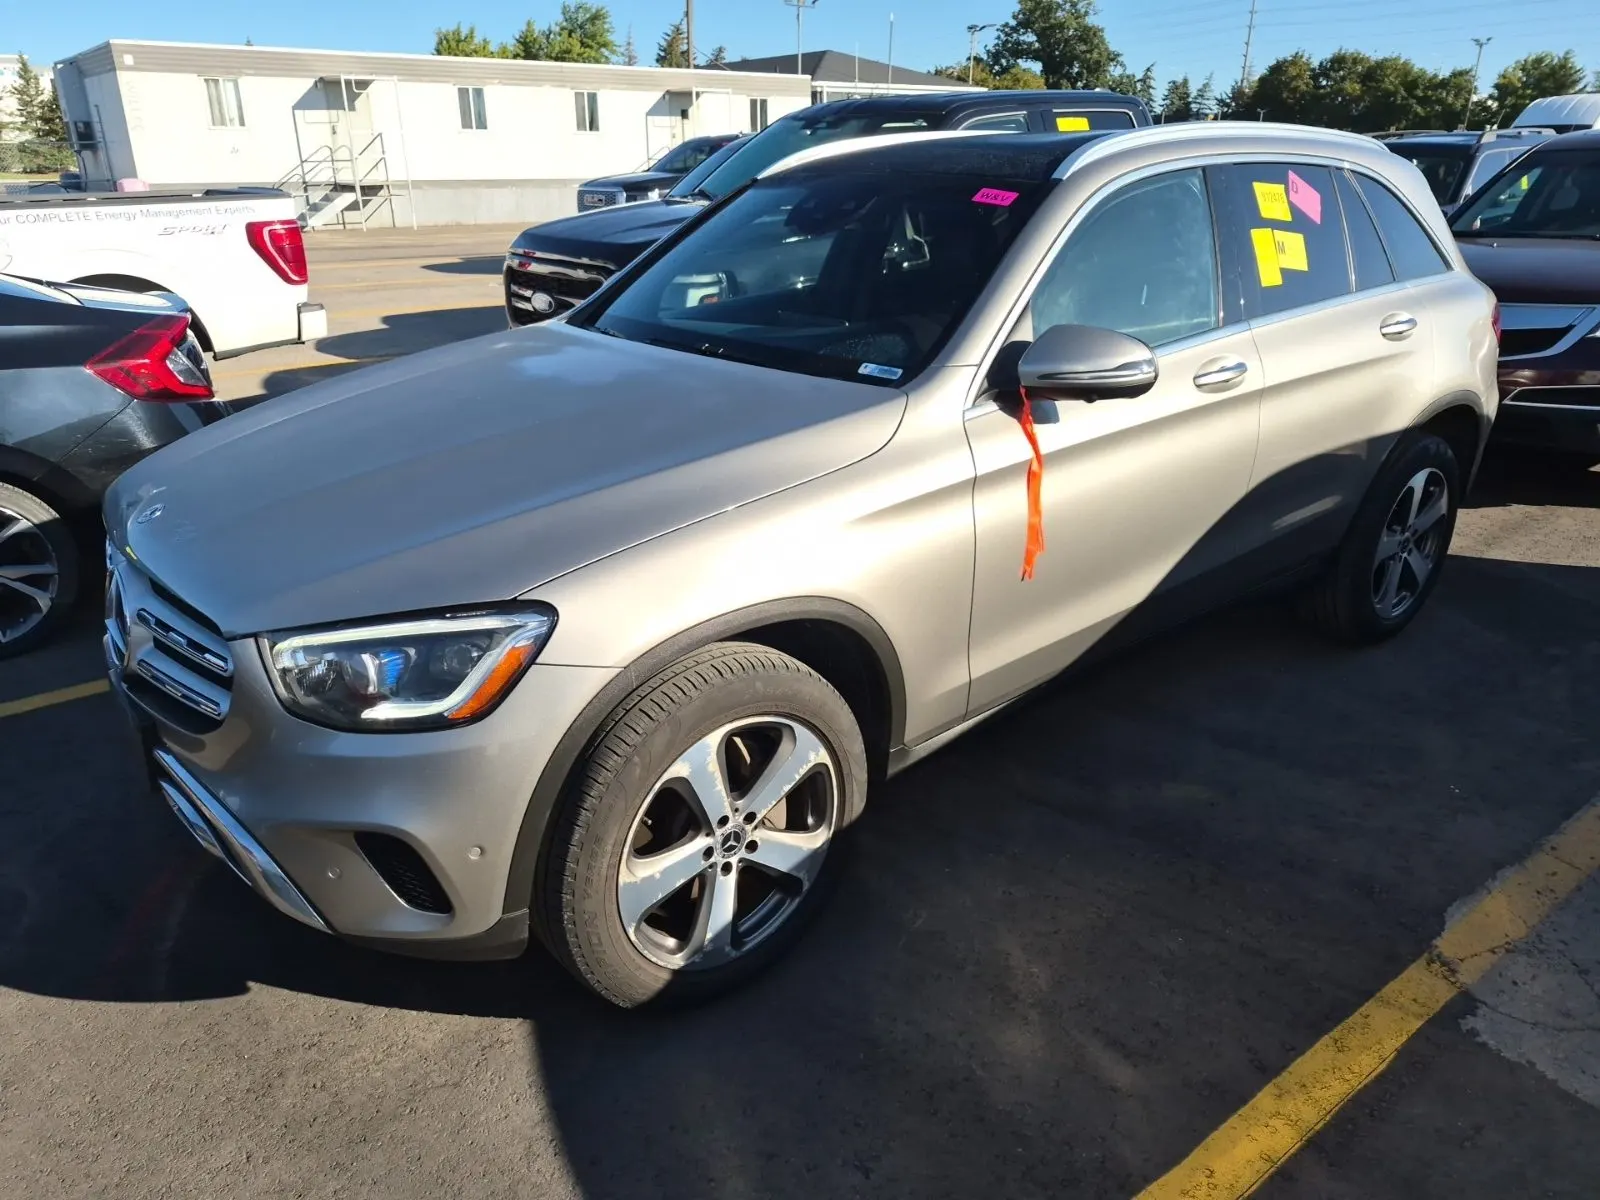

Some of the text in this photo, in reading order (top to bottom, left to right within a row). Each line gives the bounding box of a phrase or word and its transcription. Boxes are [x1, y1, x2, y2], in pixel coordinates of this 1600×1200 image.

[16, 210, 91, 224] COMPLETE
[96, 210, 137, 221] Energy
[140, 207, 212, 219] Management
[215, 205, 256, 215] Experts
[1277, 241, 1286, 254] M
